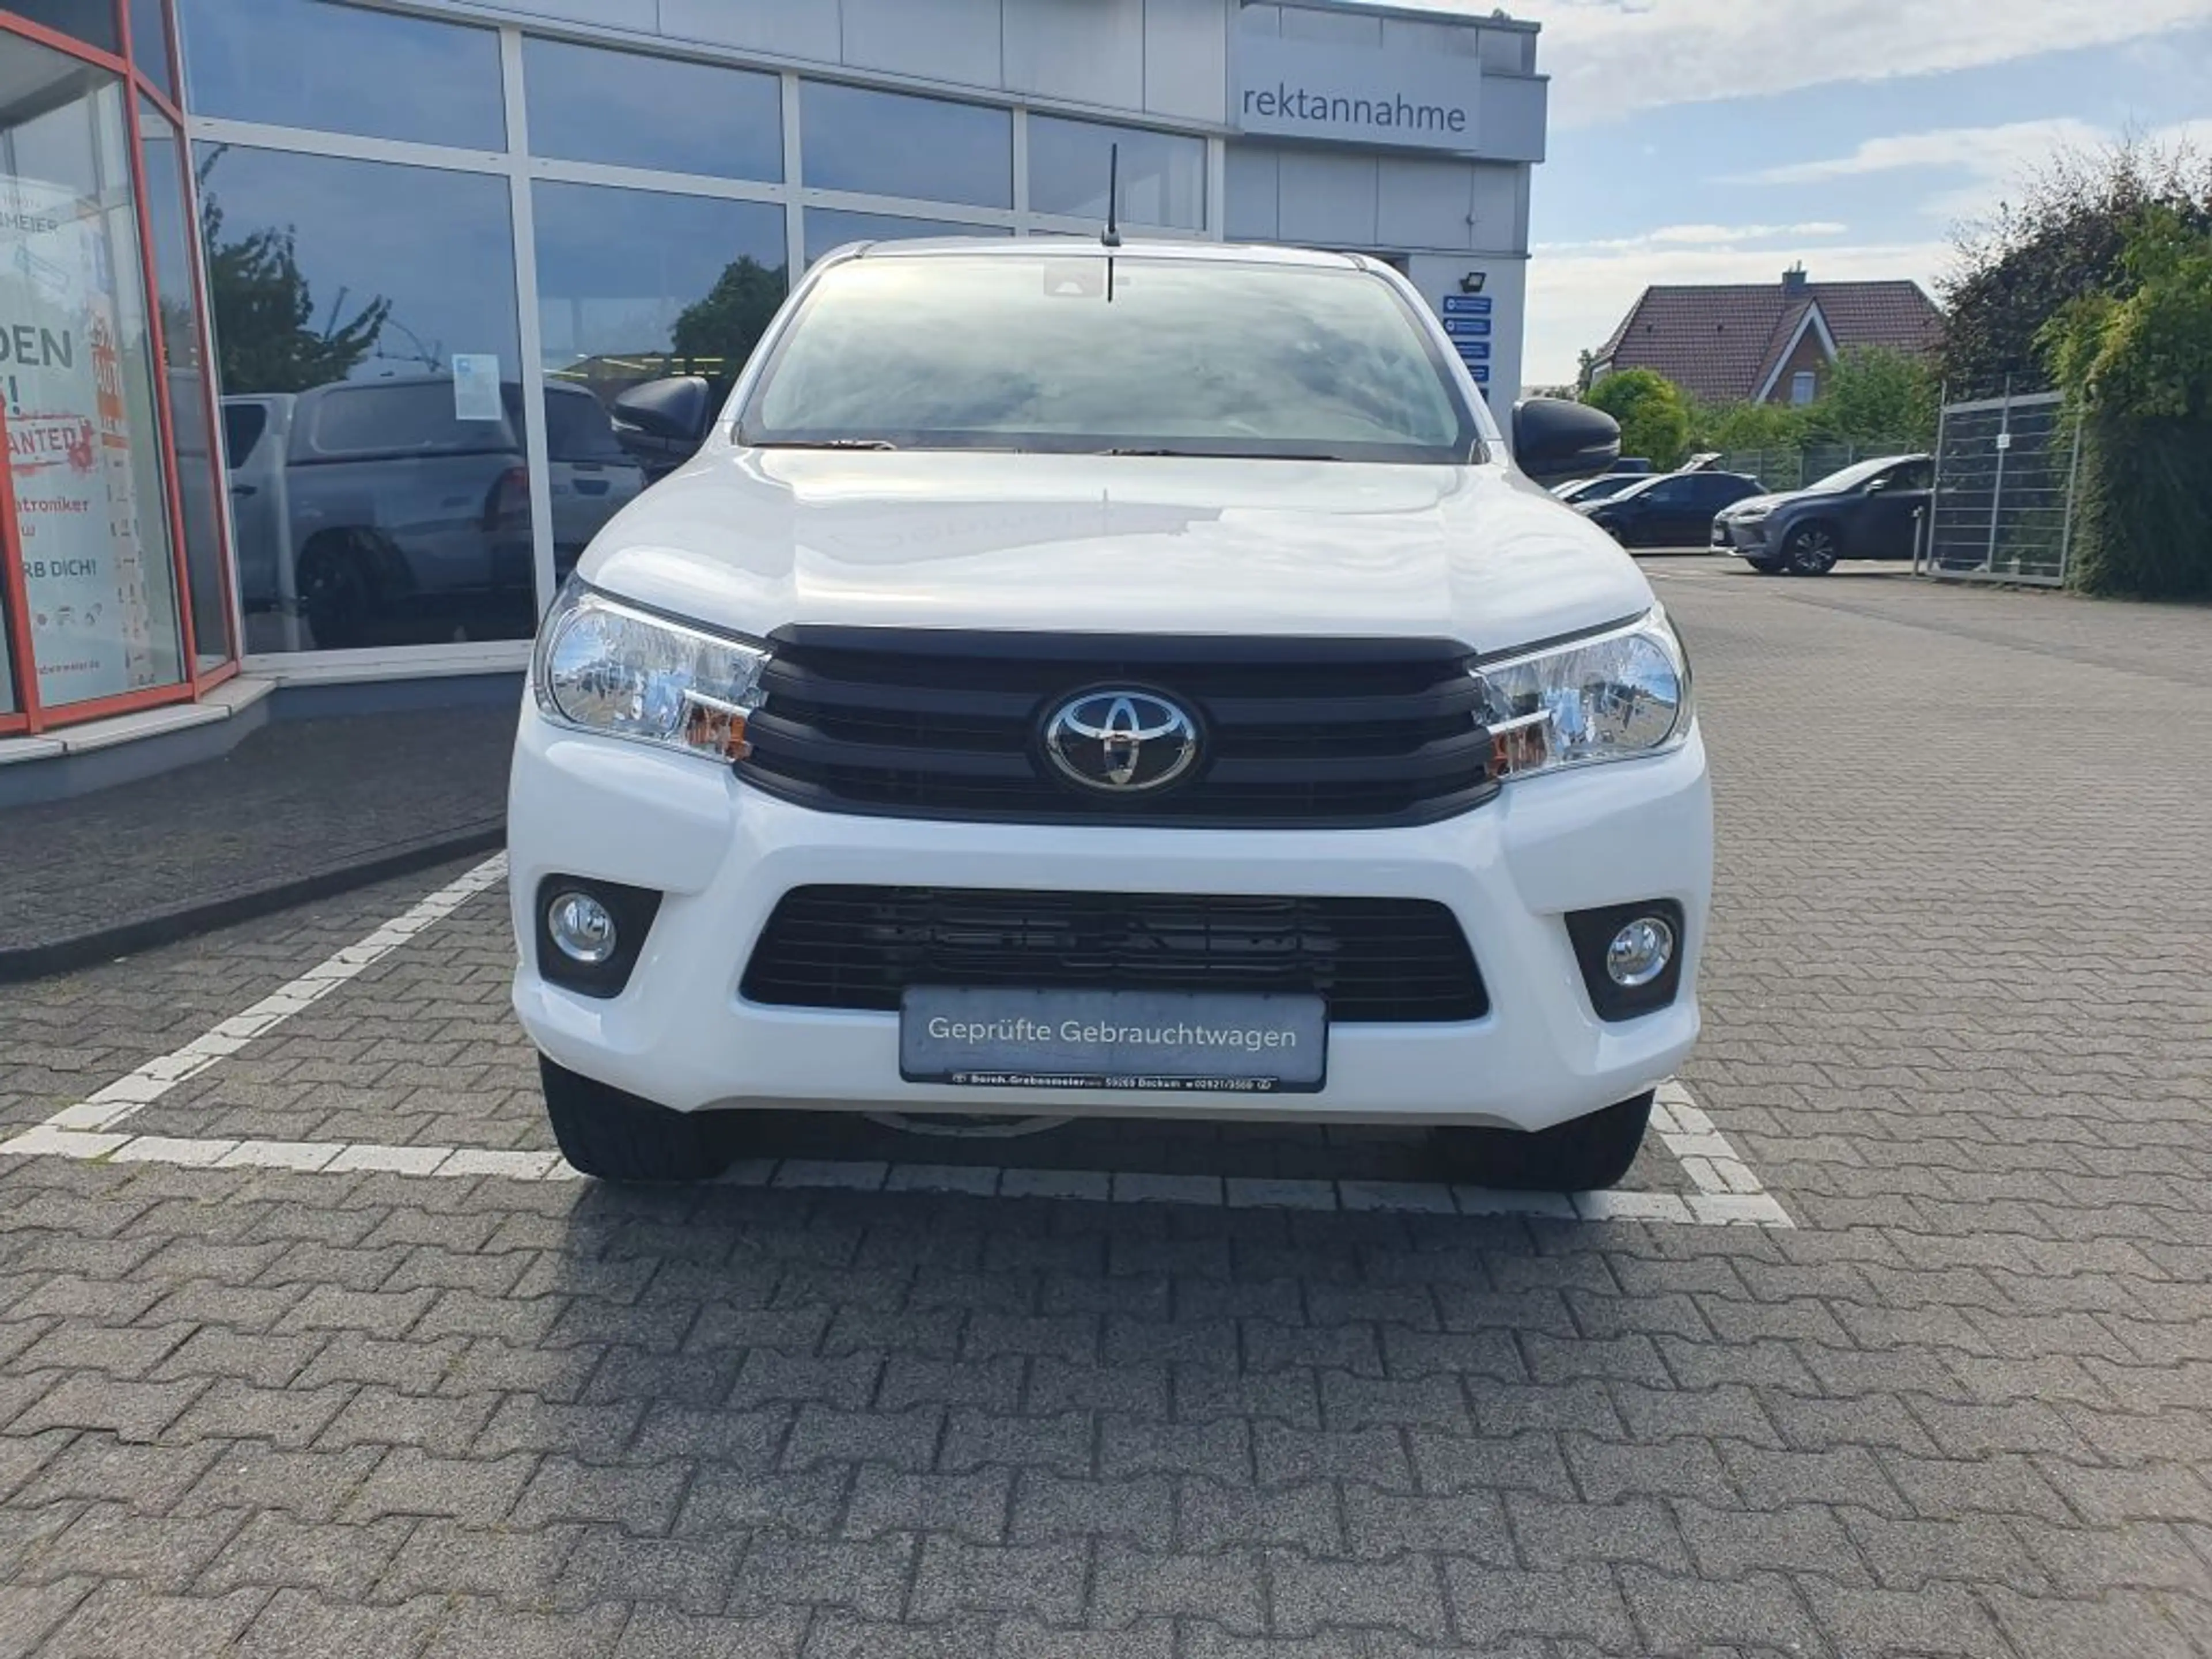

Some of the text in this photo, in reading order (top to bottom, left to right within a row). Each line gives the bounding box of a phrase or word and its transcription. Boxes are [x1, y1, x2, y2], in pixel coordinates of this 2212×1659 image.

[1243, 81, 1466, 132] rektannahme
[51, 558, 97, 577] DICH!
[928, 1016, 1296, 1051] Geprüfte Gebrauchtwagen
